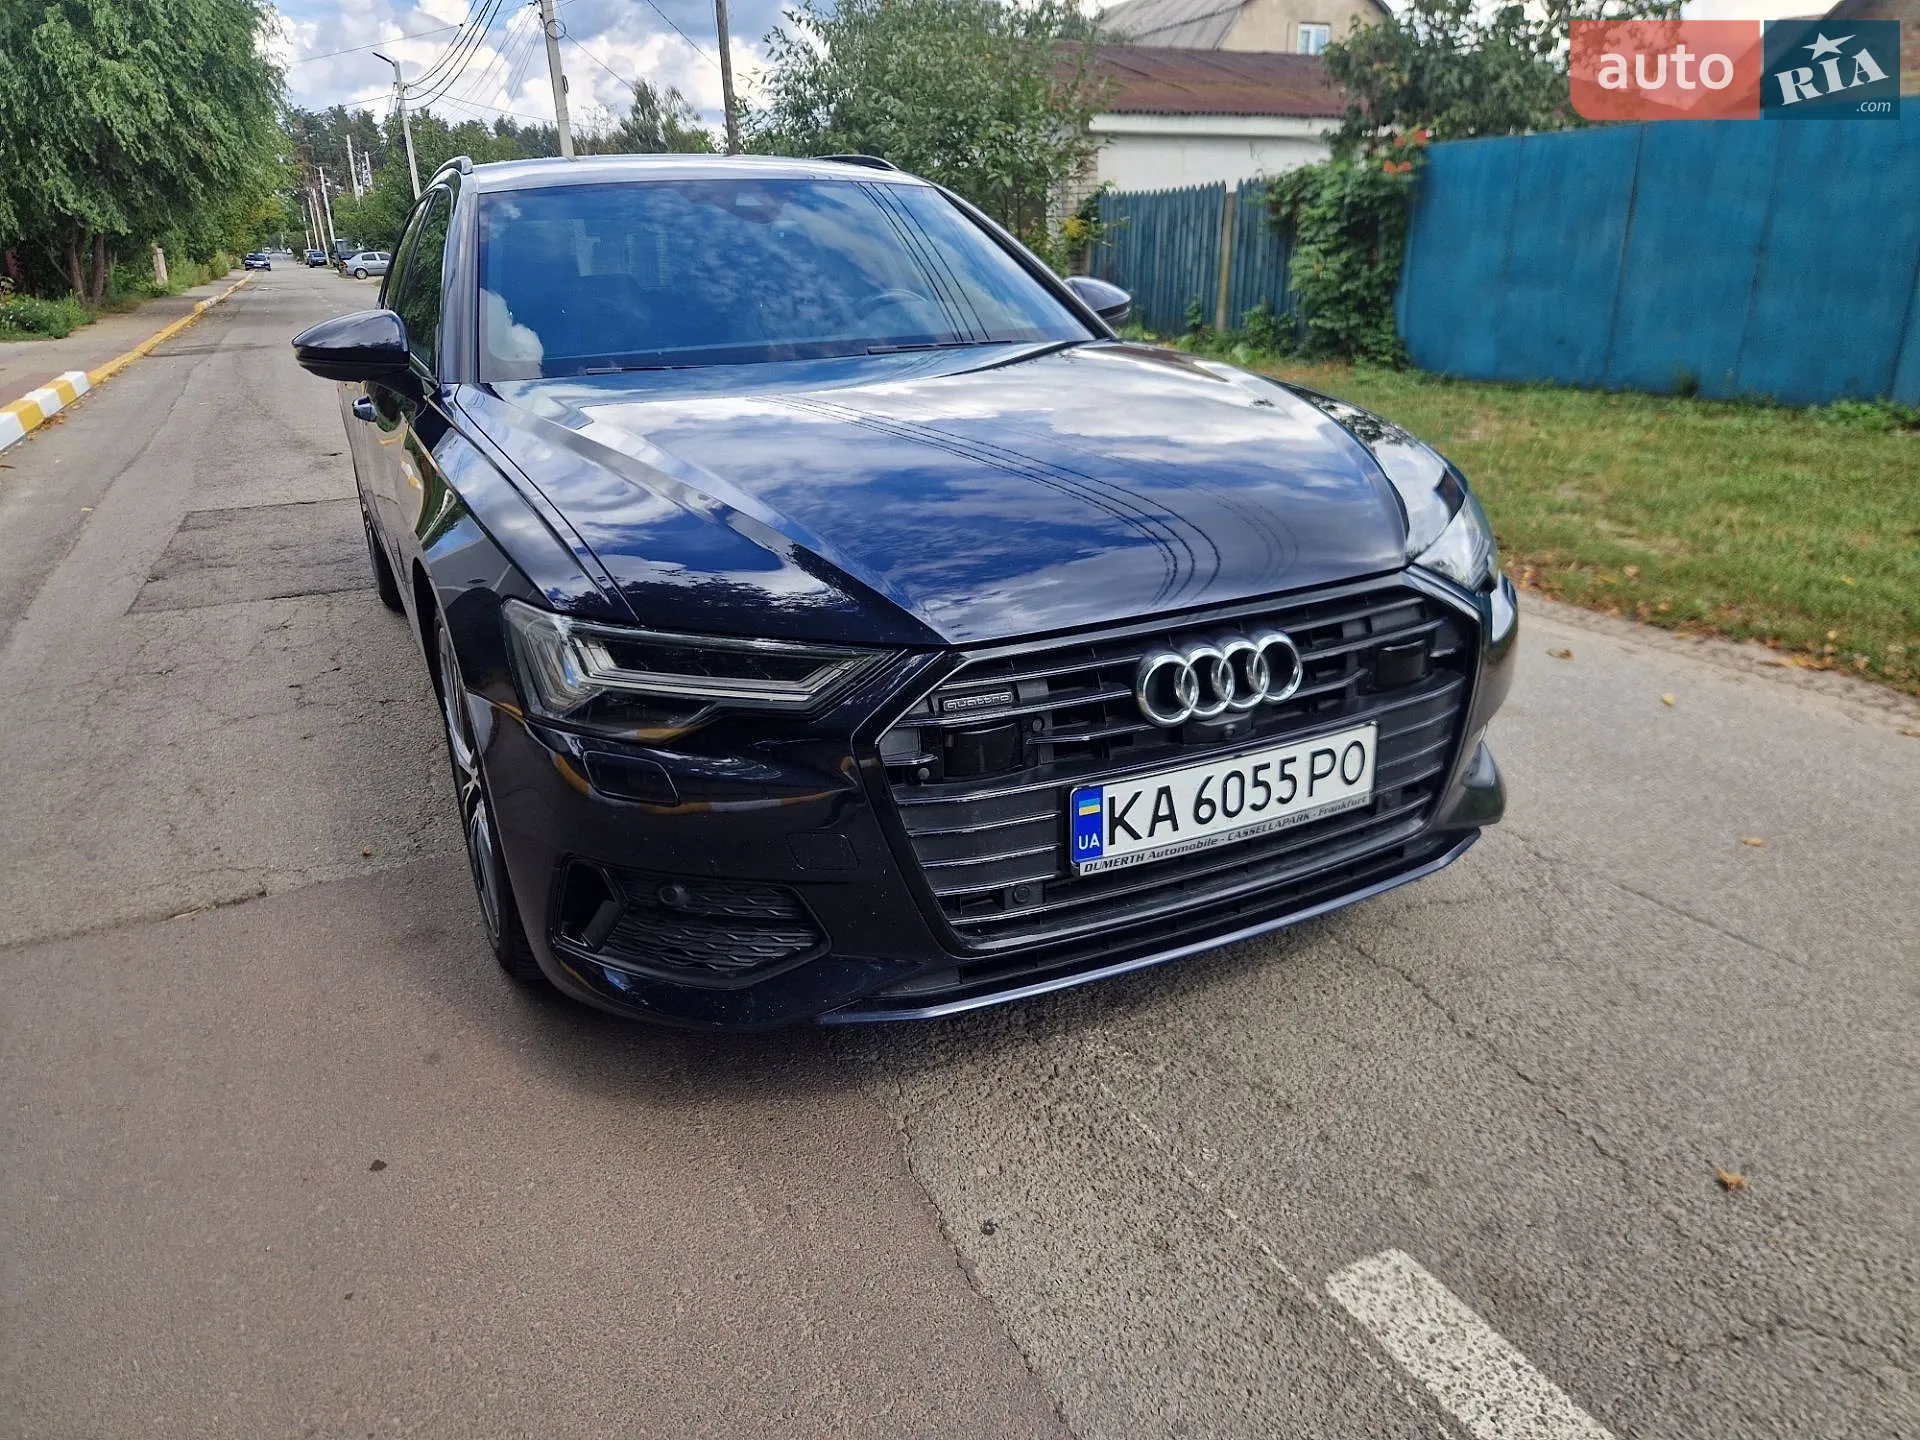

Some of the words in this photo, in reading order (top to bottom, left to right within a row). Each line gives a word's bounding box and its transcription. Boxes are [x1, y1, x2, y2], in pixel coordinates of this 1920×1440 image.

[946, 692, 1011, 710] quattro
[1078, 833, 1100, 850] UA
[1084, 853, 1145, 873] DUMERTH
[1147, 838, 1219, 859] Automobile
[1227, 814, 1310, 841] CASSELLAPARK
[1318, 795, 1367, 816] Frankfurt
